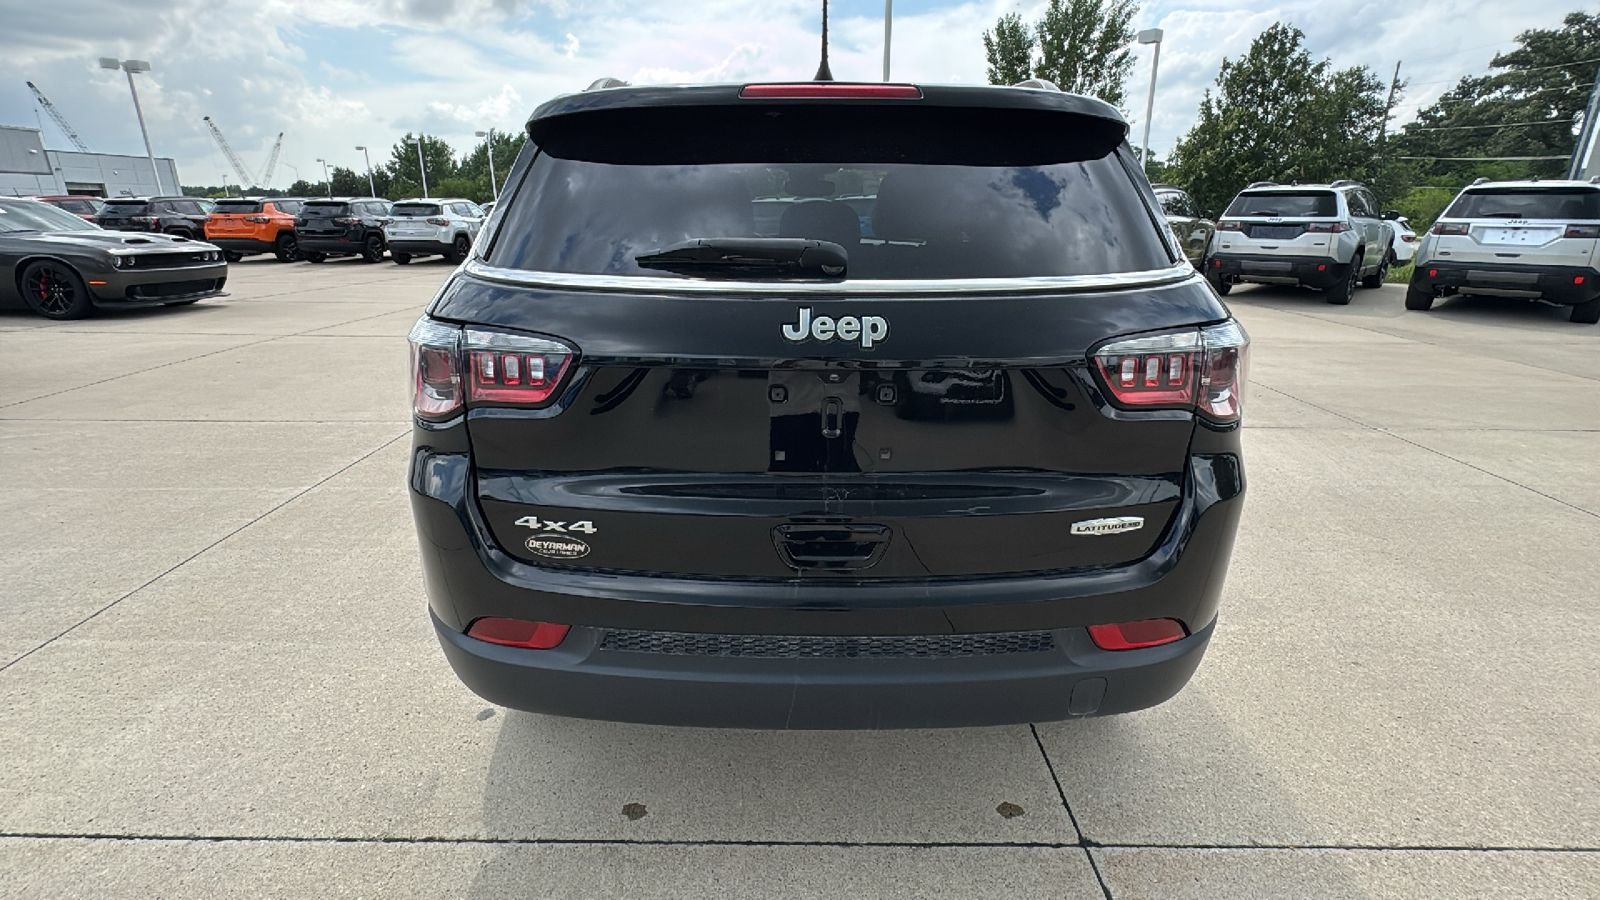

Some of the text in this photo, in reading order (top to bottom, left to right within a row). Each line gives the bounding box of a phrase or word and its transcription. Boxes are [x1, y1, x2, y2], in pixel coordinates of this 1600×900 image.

[782, 307, 888, 347] Jeep
[514, 516, 598, 534] 4x4
[1076, 522, 1127, 533] LATITUDE
[528, 539, 586, 552] DEYARMAN
